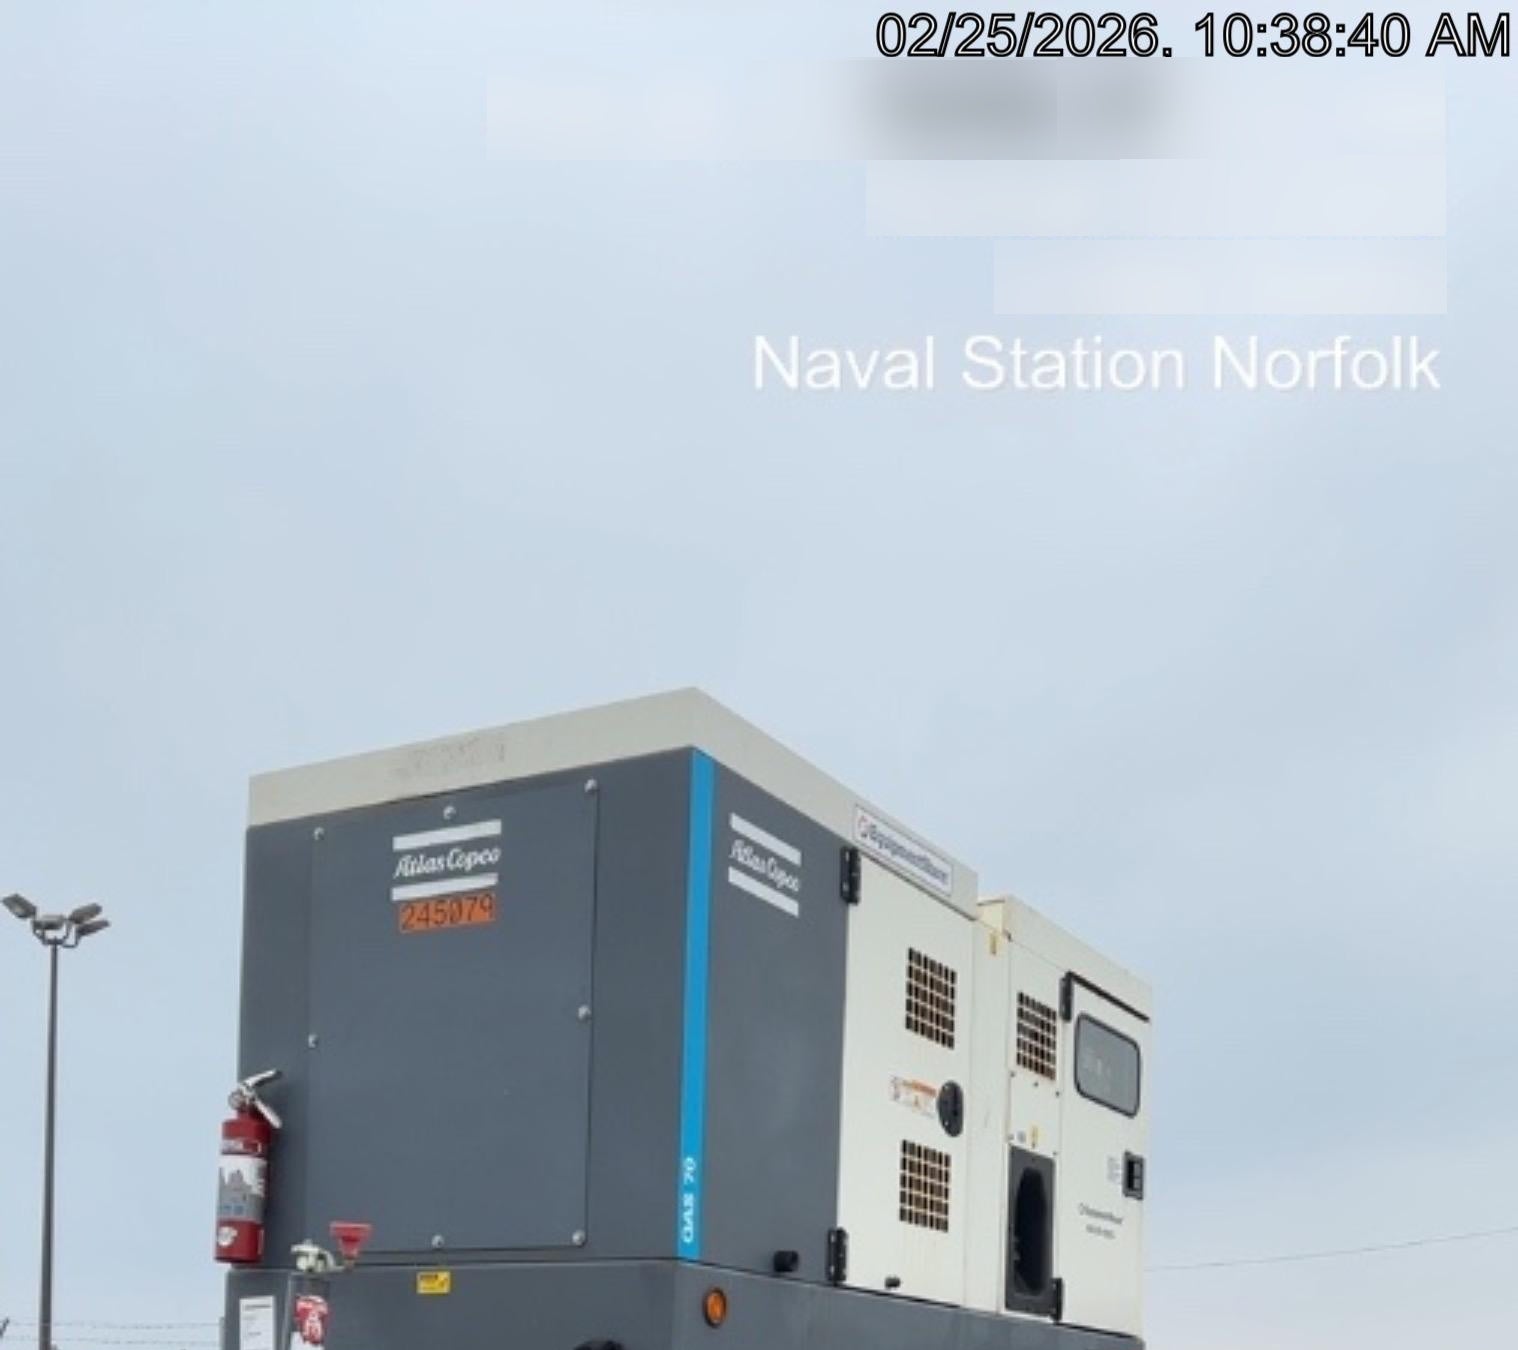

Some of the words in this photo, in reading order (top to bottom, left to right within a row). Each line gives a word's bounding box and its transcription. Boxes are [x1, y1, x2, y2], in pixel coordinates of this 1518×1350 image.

[393, 853, 445, 880] Atlas
[446, 846, 502, 872] Copco
[728, 838, 766, 874] Atlas
[400, 893, 494, 930] 245079
[683, 1157, 697, 1185] 70
